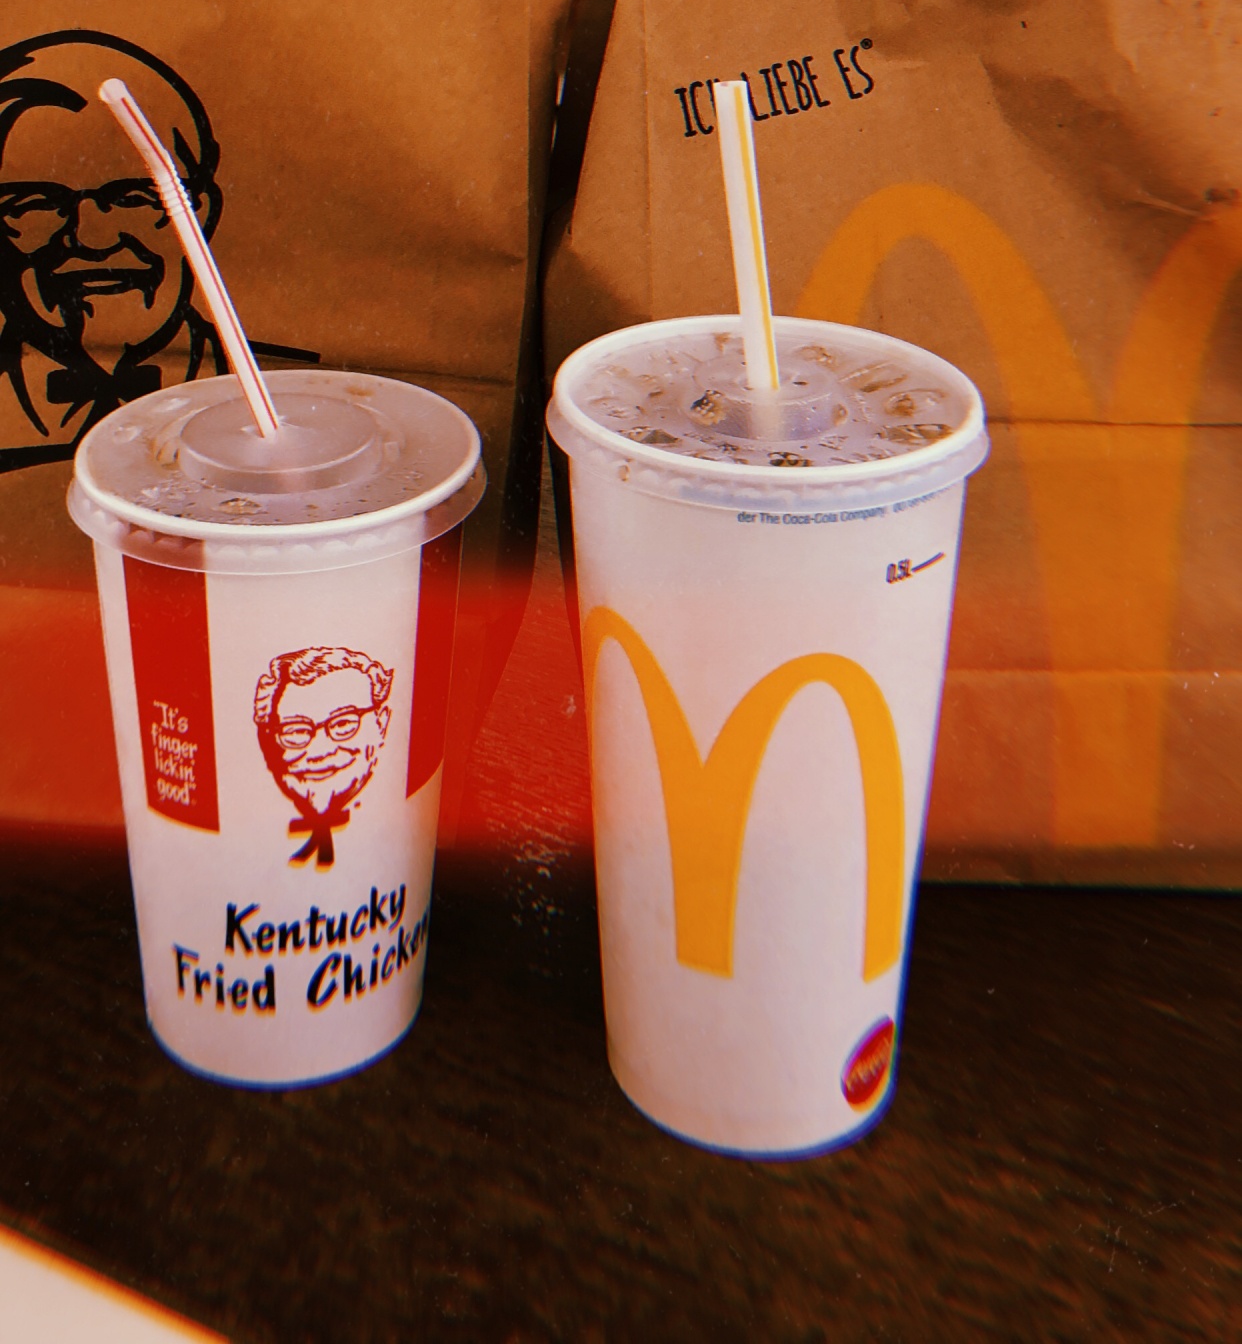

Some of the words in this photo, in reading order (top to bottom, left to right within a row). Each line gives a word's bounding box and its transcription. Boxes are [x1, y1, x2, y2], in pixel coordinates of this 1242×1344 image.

[740, 56, 831, 122] LIEBE
[759, 512, 781, 525] The
[782, 512, 838, 525] Coca-Cola
[151, 722, 198, 761] finger
[225, 883, 407, 957] Kentucky
[172, 943, 277, 1017] Fried
